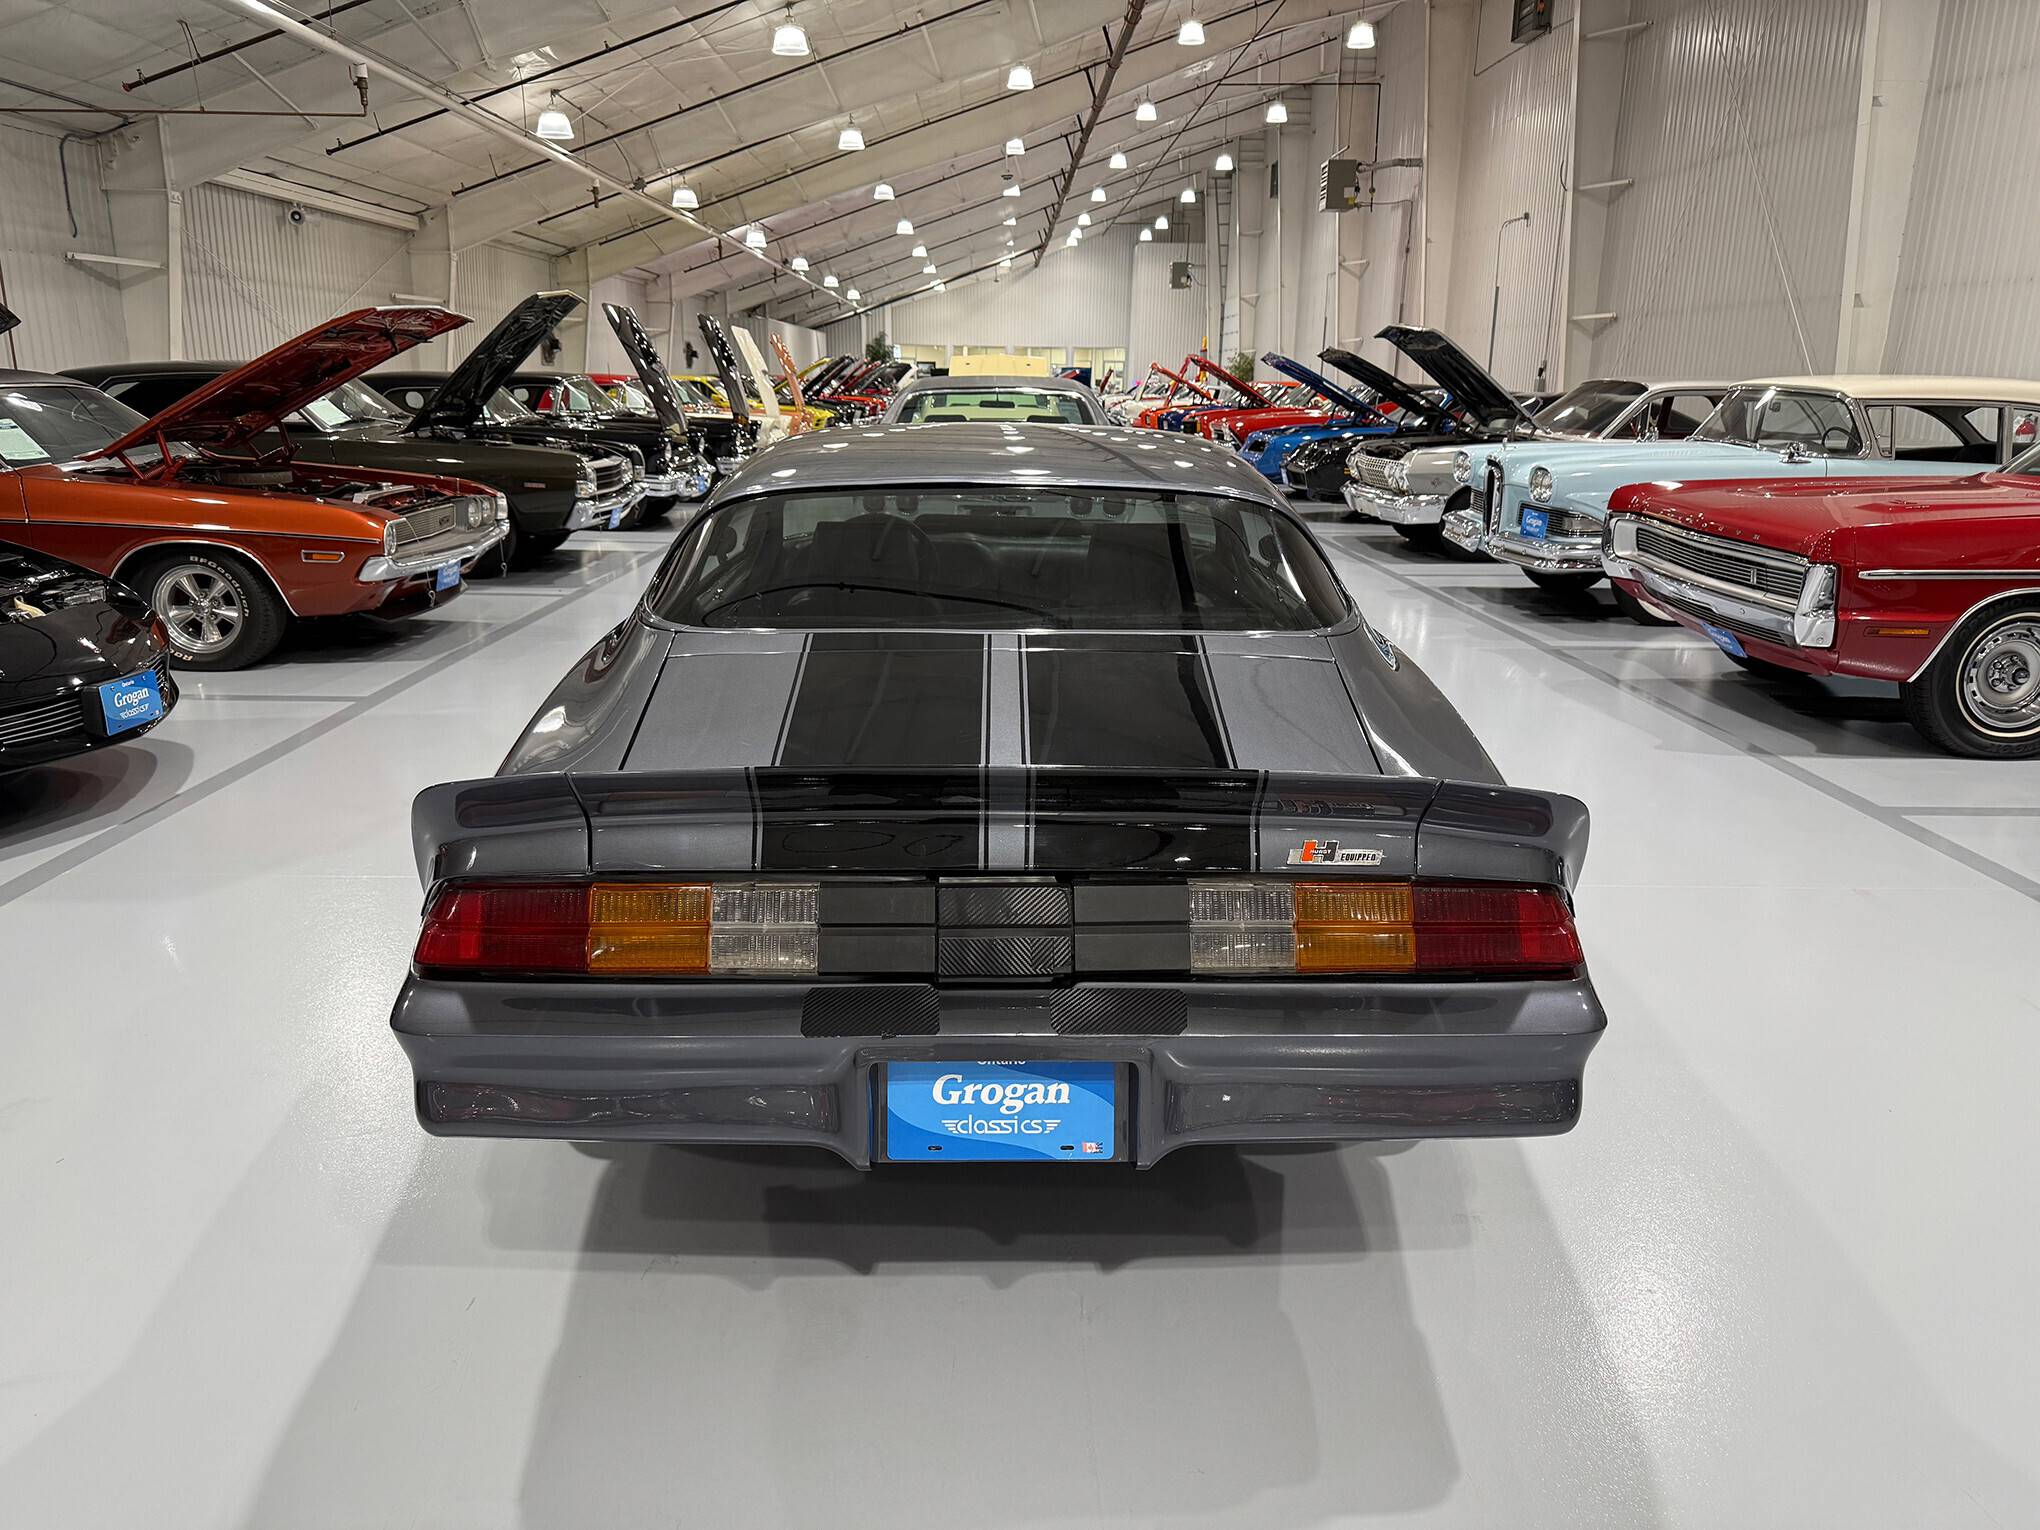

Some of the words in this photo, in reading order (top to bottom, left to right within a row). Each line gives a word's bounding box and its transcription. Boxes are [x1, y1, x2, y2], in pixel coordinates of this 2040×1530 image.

[114, 688, 150, 708] Grogan
[1340, 853, 1377, 861] EQUIPPED
[932, 1074, 1070, 1115] Grogan
[956, 1115, 1044, 1135] classics
